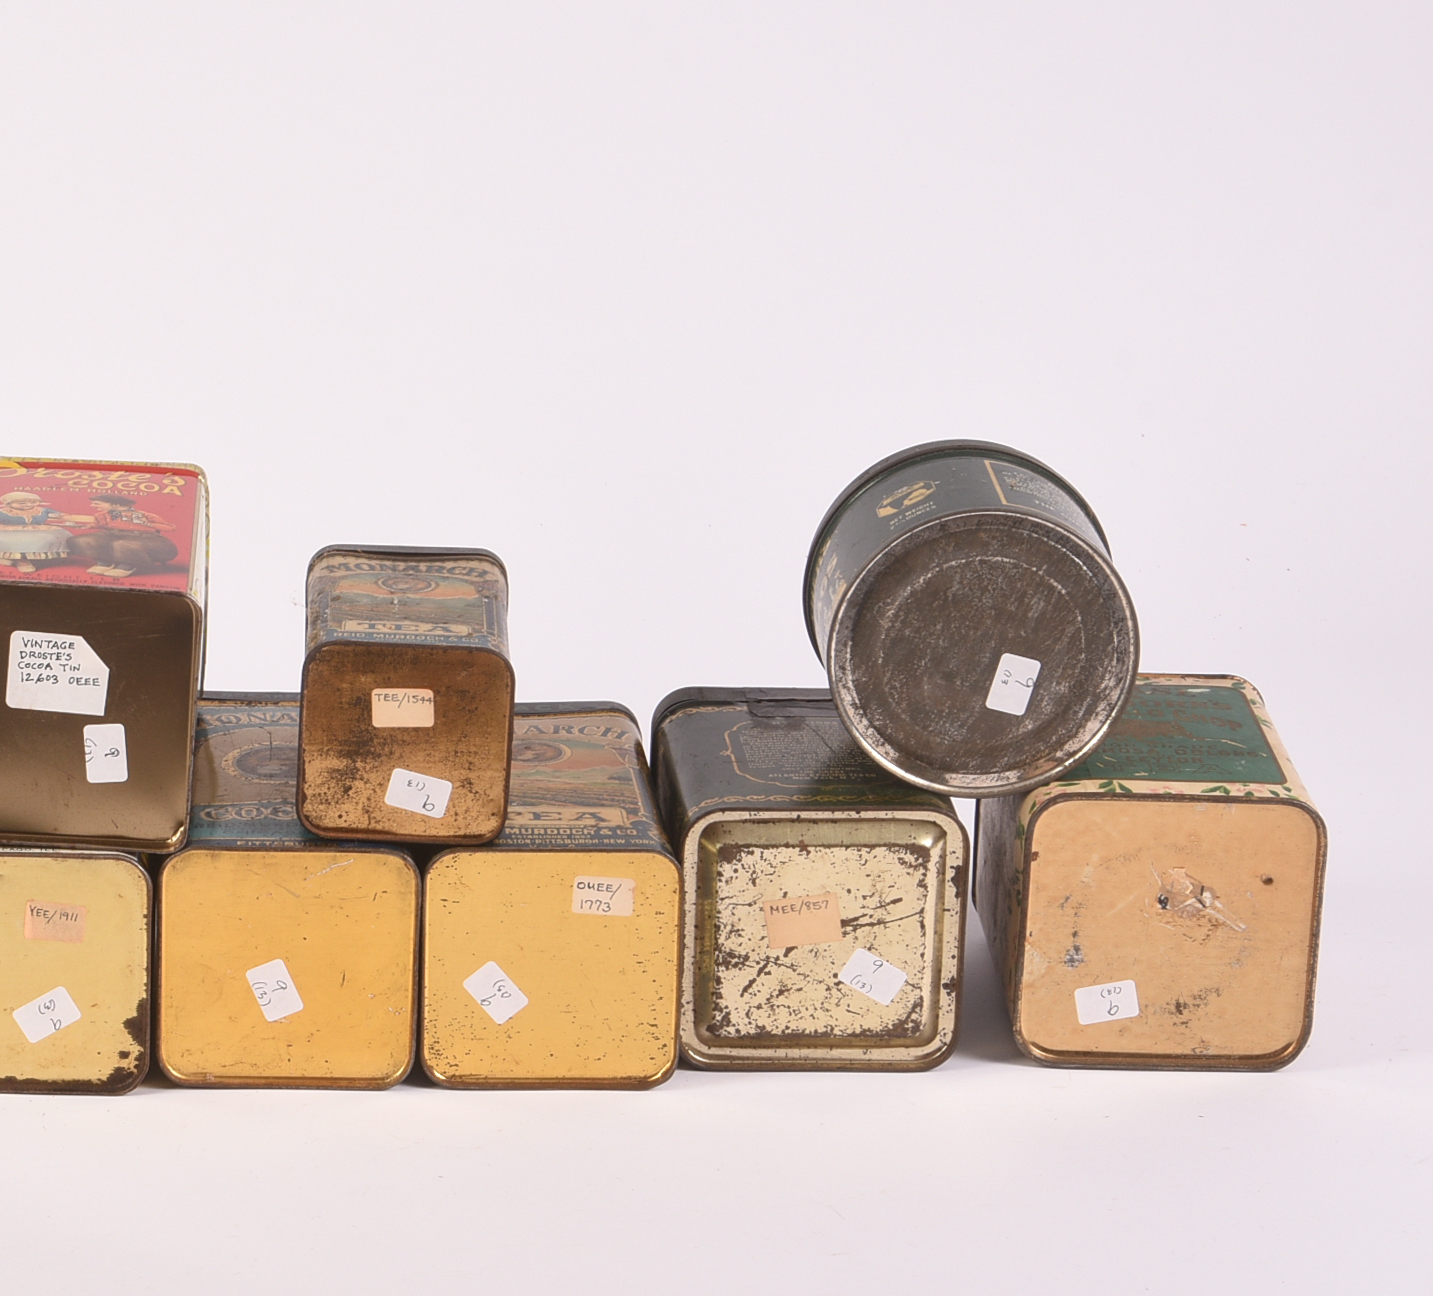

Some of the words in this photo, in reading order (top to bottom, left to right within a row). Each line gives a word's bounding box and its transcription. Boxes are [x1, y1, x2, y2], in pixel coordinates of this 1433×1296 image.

[68, 479, 183, 497] COCOA
[87, 488, 148, 496] HOLLAND
[320, 562, 493, 578] MONARCH
[357, 622, 456, 633] TEA
[22, 637, 75, 650] VINTAGE
[373, 633, 444, 641] MURDOCH
[19, 651, 72, 661] DROSTE'S
[18, 661, 53, 670] COCOA
[59, 663, 81, 672] TIN
[68, 676, 101, 686] OEEE
[374, 693, 434, 708] TEE/1544
[514, 725, 631, 739] ARCH
[200, 804, 297, 821] COC
[504, 827, 596, 835] MURDOCH
[599, 827, 612, 835] &
[617, 828, 642, 836] CO.
[580, 899, 611, 913] 1773
[769, 899, 829, 915] MEE/857
[29, 904, 79, 925] YEE/1911
[872, 959, 884, 974] 9
[850, 974, 873, 993] (13)
